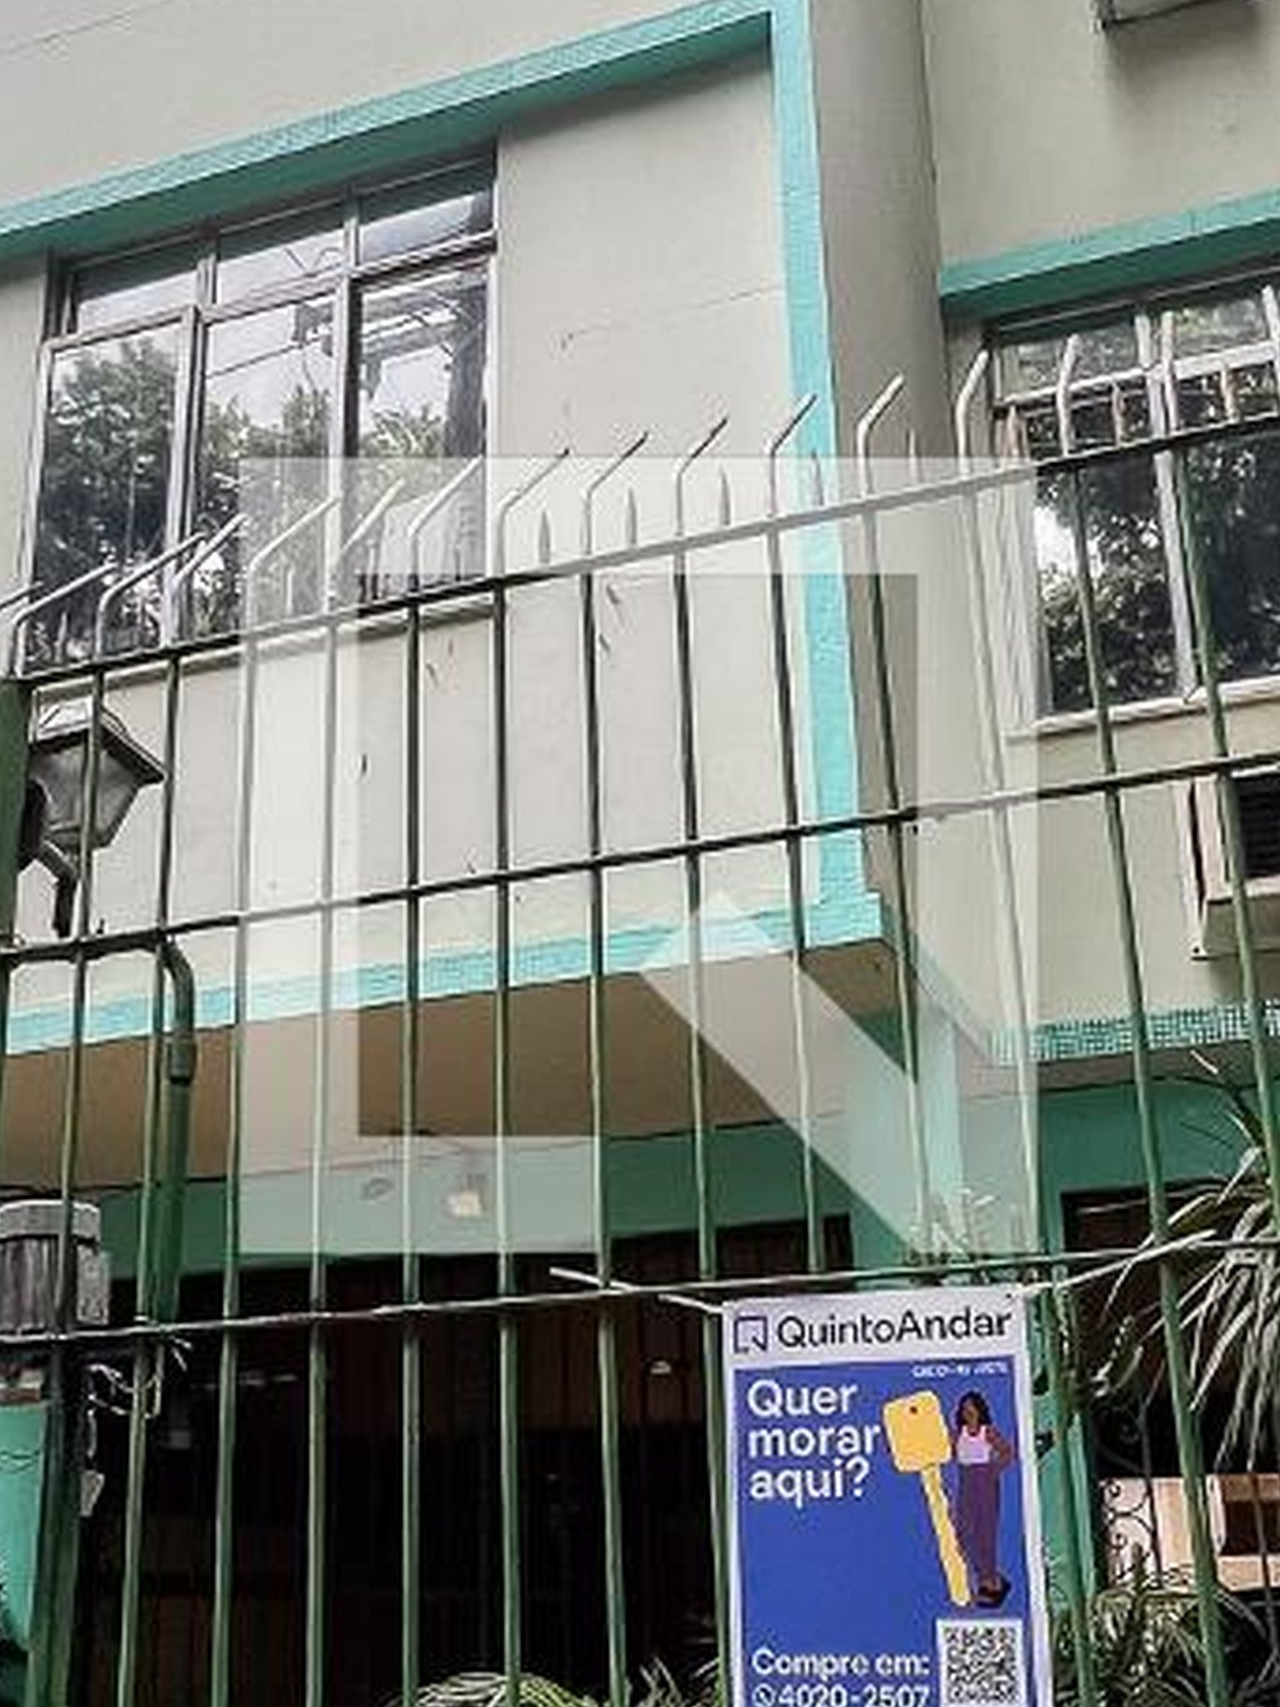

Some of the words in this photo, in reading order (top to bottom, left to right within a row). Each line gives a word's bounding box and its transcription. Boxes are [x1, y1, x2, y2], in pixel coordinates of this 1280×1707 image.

[776, 1306, 1011, 1348] QuintoAndar
[748, 1378, 858, 1418] Quer
[749, 1424, 881, 1458] morar
[750, 1456, 870, 1509] aqui?
[752, 1647, 870, 1682] Compre
[875, 1653, 931, 1676] em:
